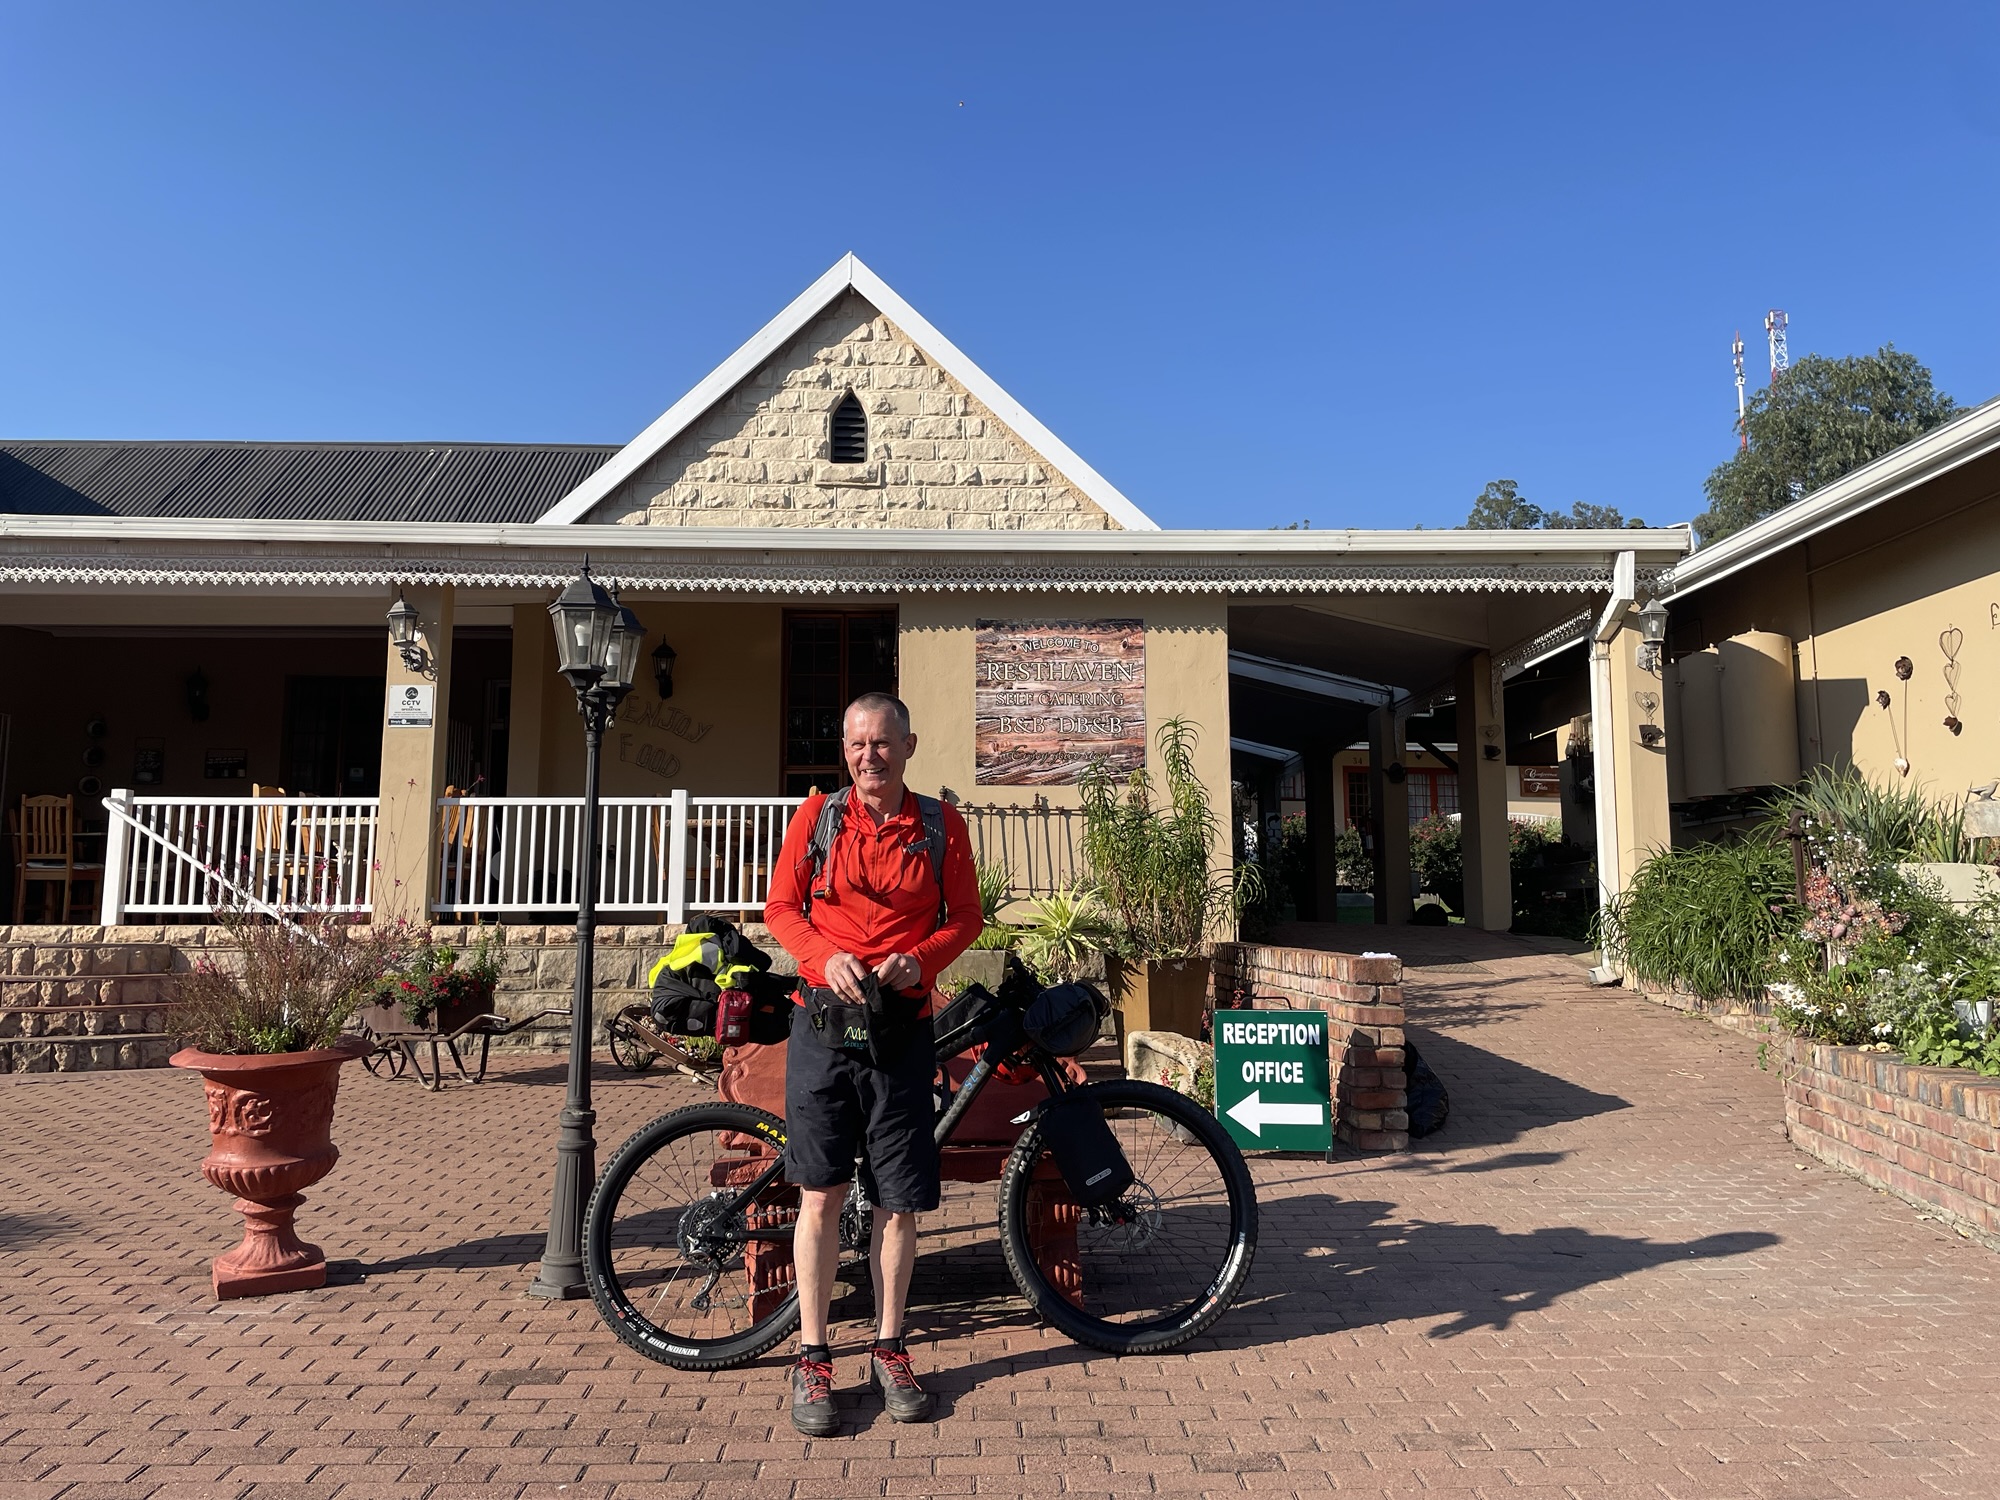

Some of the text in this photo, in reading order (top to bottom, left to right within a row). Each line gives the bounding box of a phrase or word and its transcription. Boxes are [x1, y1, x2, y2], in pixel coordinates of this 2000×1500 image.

[1021, 638, 1099, 653] WELCOME TO
[986, 662, 1134, 681] RESTHAVEN
[996, 692, 1124, 706] SELF CATERING
[619, 695, 714, 743] ENJOY
[1000, 717, 1122, 734] B&B DB&B
[619, 733, 680, 778] FOOD
[1011, 744, 1048, 766] Enjoy
[1352, 756, 1363, 765] 34
[1222, 1023, 1320, 1045] RECEPTION
[1242, 1061, 1304, 1083] OFFICE
[756, 1122, 788, 1145] MAX
[633, 1316, 656, 1333] SWISS
